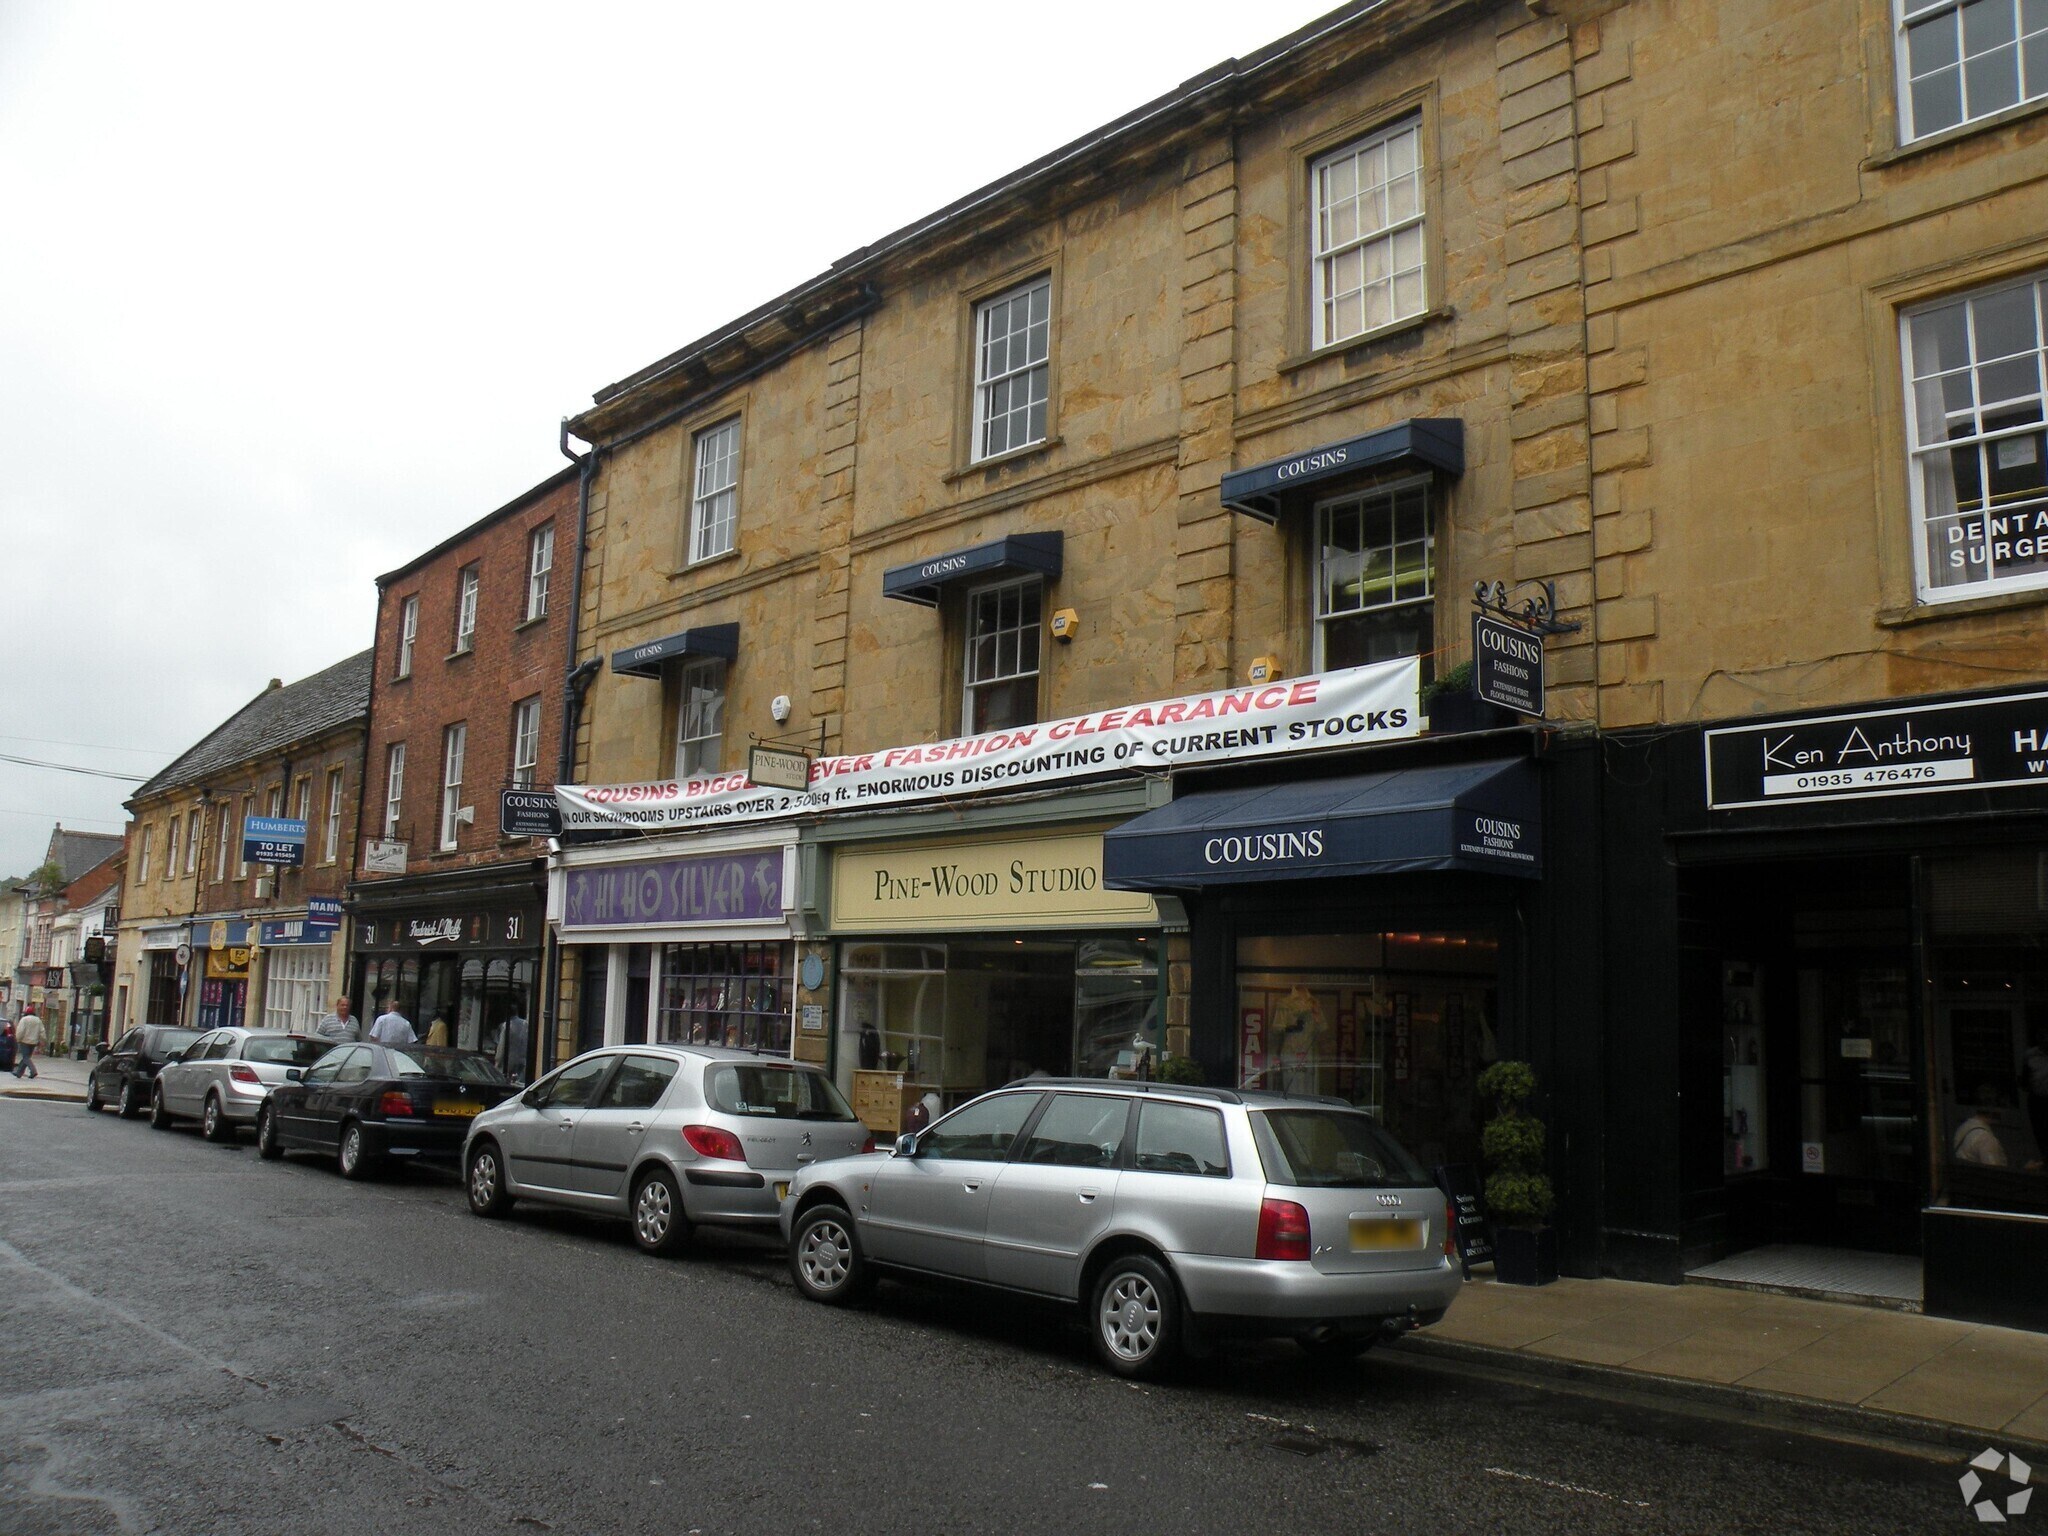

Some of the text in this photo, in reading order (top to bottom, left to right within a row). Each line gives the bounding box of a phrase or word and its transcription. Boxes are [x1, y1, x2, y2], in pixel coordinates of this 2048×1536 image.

[1277, 448, 1347, 479] COUSINS
[921, 556, 967, 578] COUSINS
[634, 643, 663, 660] COUSINS
[1481, 628, 1539, 664] COUSINS
[1494, 659, 1529, 680] FASHIONS
[583, 680, 1321, 804] COUSINS BIGG EVER FASHION CLEARANCE
[1764, 721, 1971, 771] Ken Anthony
[572, 812, 592, 823] OUR
[594, 810, 664, 824] SHOWROOMS
[669, 803, 732, 821] UPSTAIRS
[736, 799, 775, 814] OVER
[835, 787, 851, 801] ft.
[857, 771, 954, 798] ENORMOUS
[961, 747, 1105, 785] DISCOUNTING
[1113, 741, 1144, 759] OF
[1152, 725, 1278, 757] CURRENT
[1289, 708, 1408, 741] STOCKS
[755, 754, 806, 772] PINE-WOOD
[1797, 766, 1936, 789] 01935 476476
[507, 796, 559, 809] COUSINS
[517, 811, 549, 819] FASHIONS
[251, 821, 306, 833] HUMBERTS
[1475, 817, 1521, 840] COUSINS
[260, 843, 294, 852] TO LET
[1204, 829, 1323, 864] COUSINS
[1483, 836, 1514, 850] FASHIONS
[594, 862, 745, 918] HI HO SILVER
[310, 902, 341, 912] MANN
[365, 925, 374, 944] 31
[506, 916, 519, 940] 31
[1244, 1013, 1262, 1089] SALE
